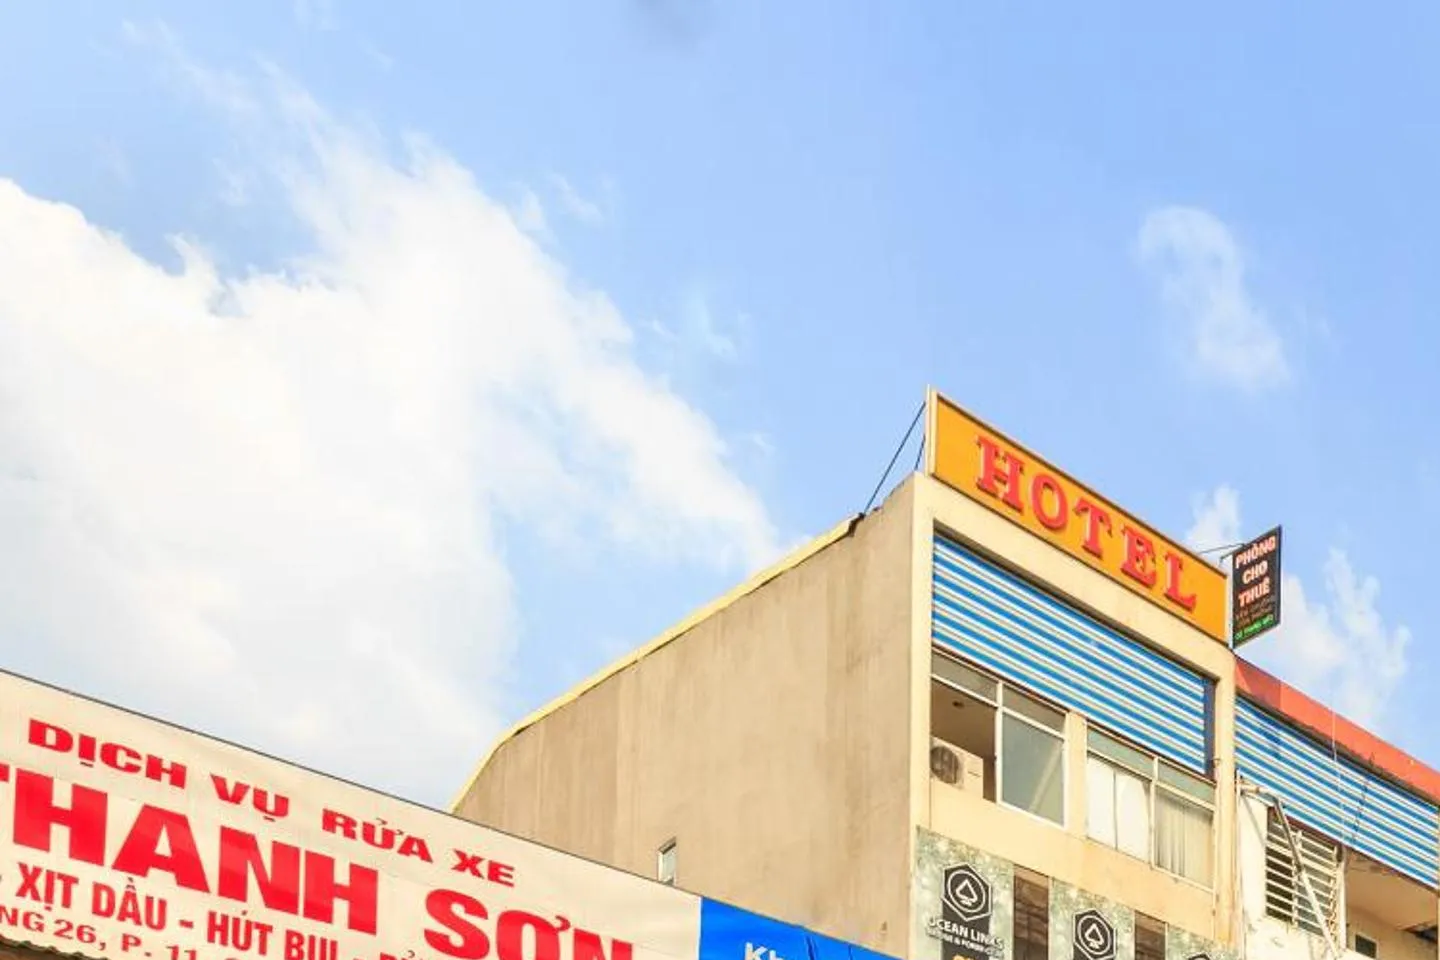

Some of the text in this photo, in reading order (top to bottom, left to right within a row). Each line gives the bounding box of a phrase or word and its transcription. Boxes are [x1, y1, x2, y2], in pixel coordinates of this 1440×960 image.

[976, 434, 1197, 614] HOTEL
[1242, 560, 1269, 586] CHO
[27, 718, 515, 889] DỊCH VỤ RỬA XE
[15, 861, 80, 912] XỊT
[90, 876, 168, 932] DẦU
[206, 909, 275, 958] HÚT
[53, 918, 107, 951] 26,
[120, 932, 153, 956] P.
[928, 914, 969, 939] OCEAN
